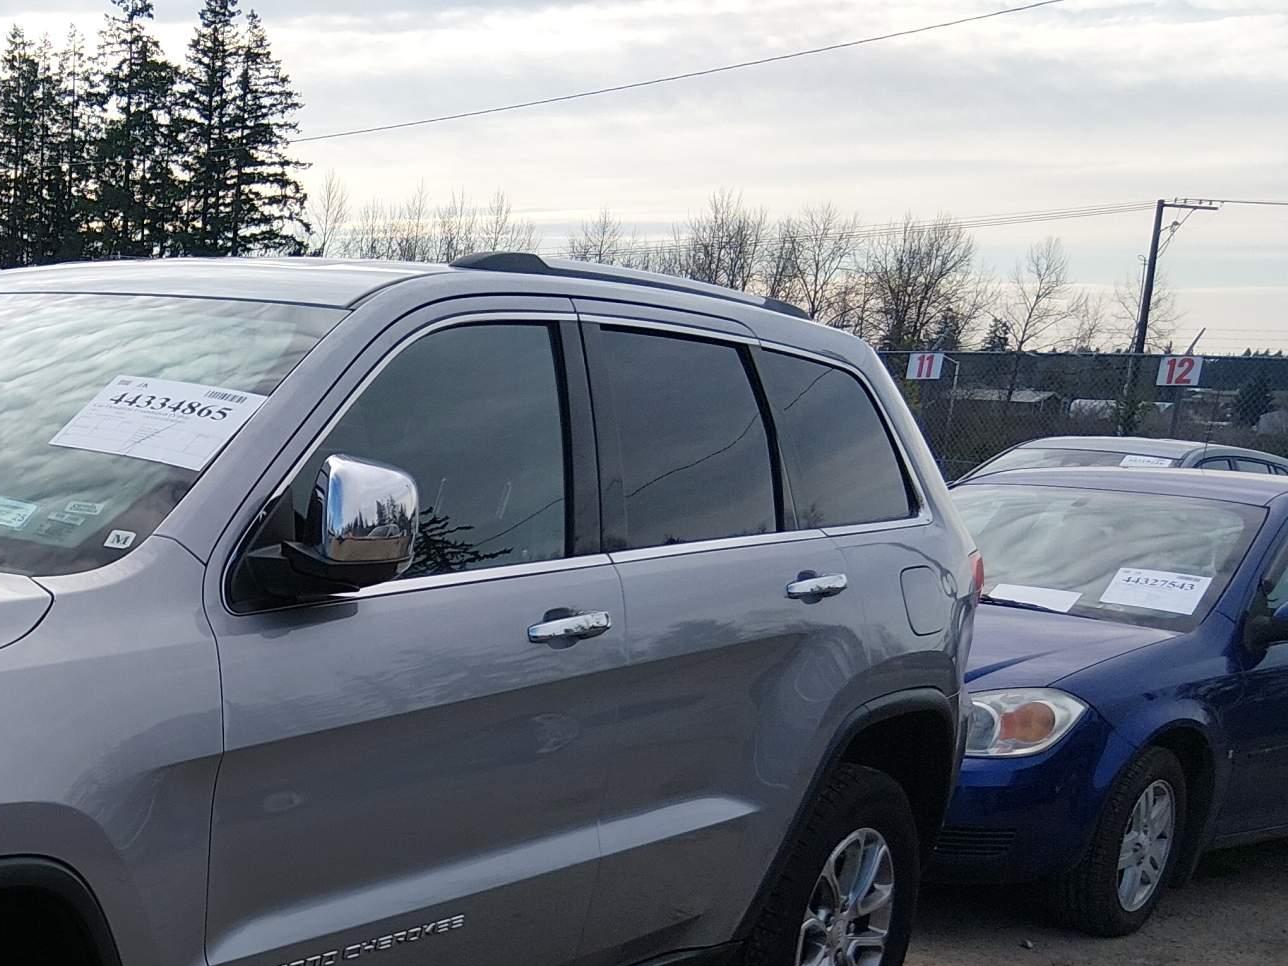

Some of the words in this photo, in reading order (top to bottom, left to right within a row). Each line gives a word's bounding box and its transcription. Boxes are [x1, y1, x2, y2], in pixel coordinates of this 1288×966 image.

[916, 354, 934, 378] 11
[1166, 357, 1195, 384] 12
[109, 392, 233, 421] 44334865
[1122, 576, 1195, 591] 44327543
[342, 914, 465, 960] CHEROKEE
